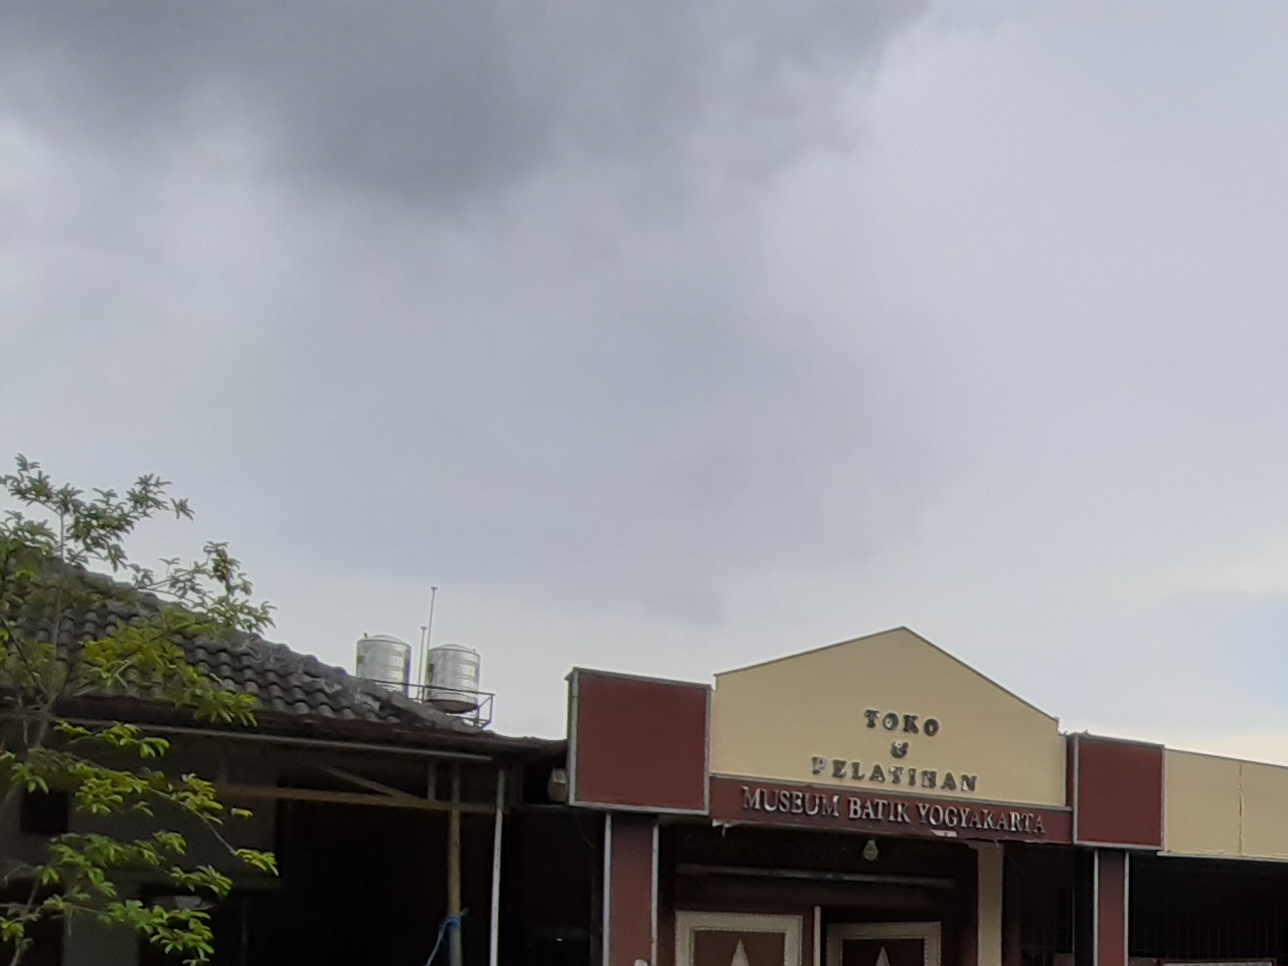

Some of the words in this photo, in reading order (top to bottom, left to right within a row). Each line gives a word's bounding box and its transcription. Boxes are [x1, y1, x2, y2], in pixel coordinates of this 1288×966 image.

[865, 709, 940, 737] TOKO
[811, 756, 978, 792] PELATIHAN
[741, 786, 840, 818] MUSEUM
[848, 797, 911, 824] BATIK
[916, 803, 1047, 834] YOGYAKARTA
